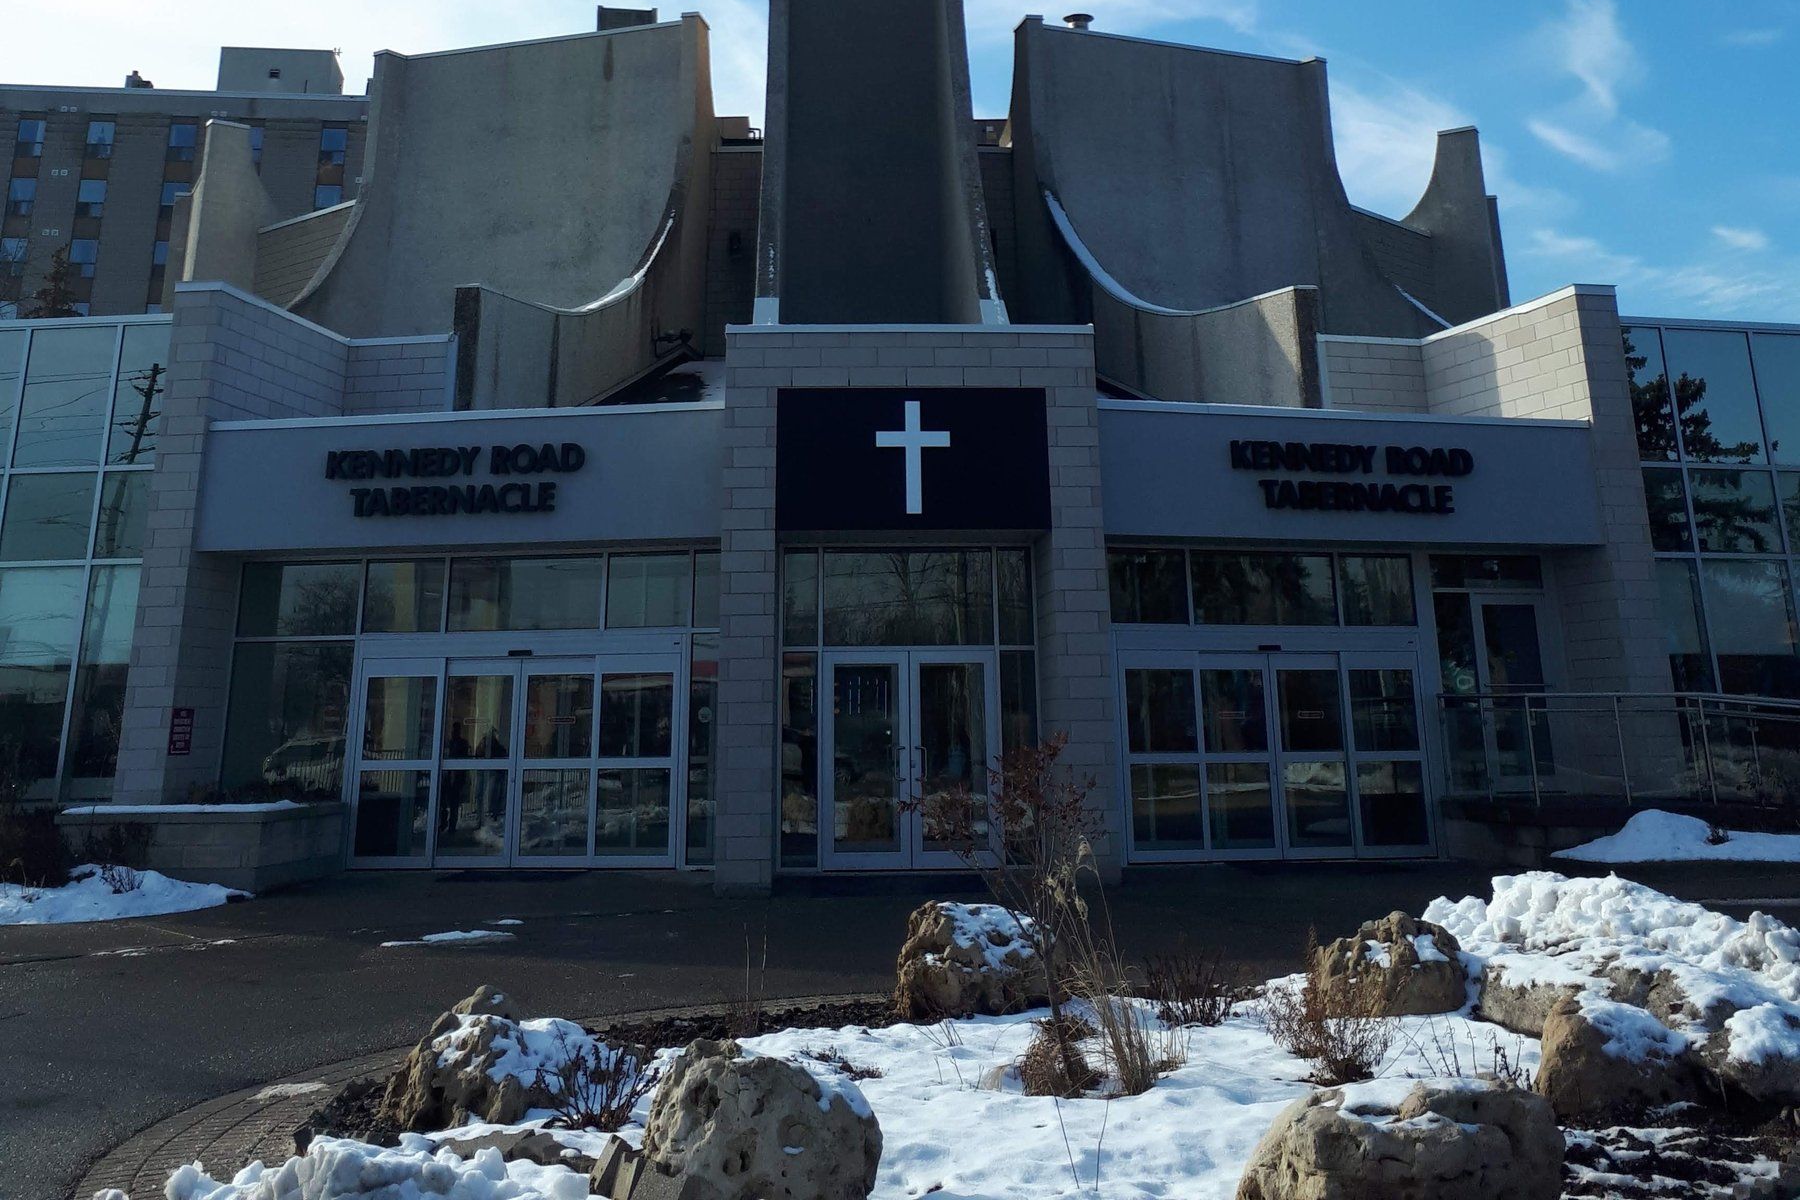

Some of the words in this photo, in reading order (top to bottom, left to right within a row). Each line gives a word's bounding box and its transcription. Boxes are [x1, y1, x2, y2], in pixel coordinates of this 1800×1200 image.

[325, 447, 481, 479] KENNEDY
[490, 443, 586, 474] ROAD
[1230, 440, 1377, 473] KENNEDY
[1385, 446, 1474, 475] ROAD
[350, 482, 556, 517] TABERNACLE
[1259, 480, 1455, 513] TABERNACLE
